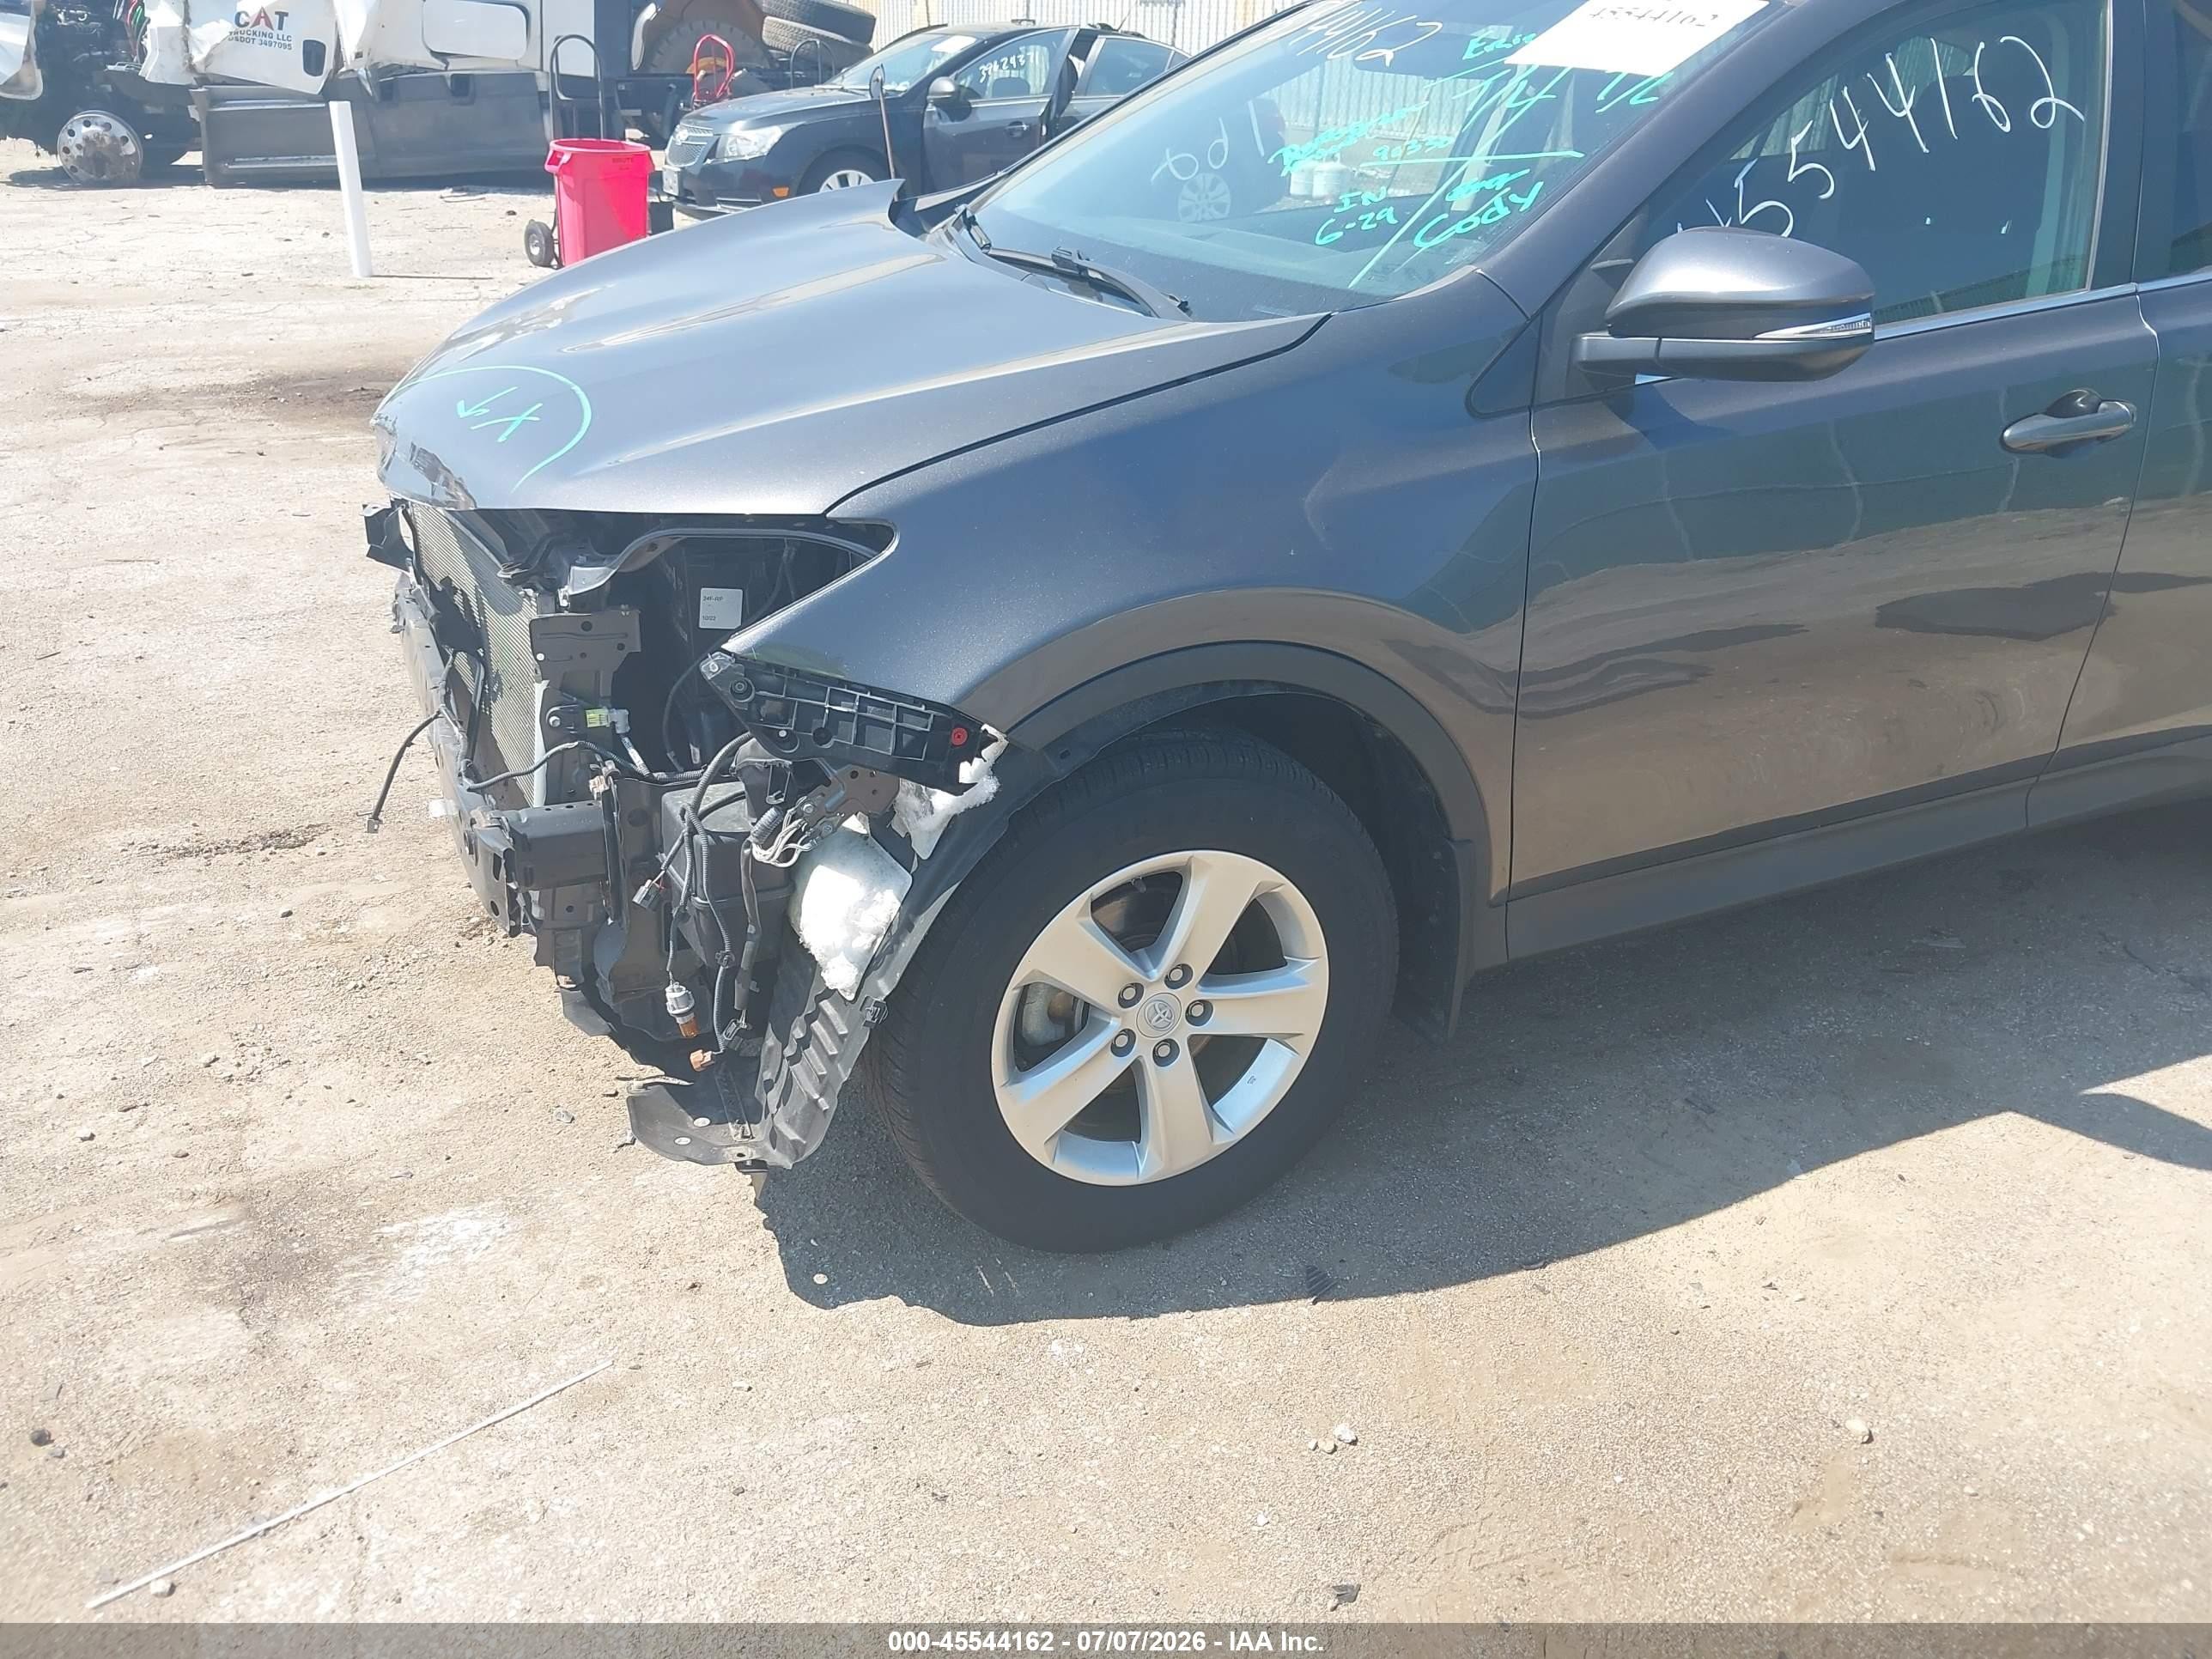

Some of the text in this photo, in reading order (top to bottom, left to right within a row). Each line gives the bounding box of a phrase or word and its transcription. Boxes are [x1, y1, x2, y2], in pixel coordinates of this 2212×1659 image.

[228, 29, 292, 42] TRUCKING LLC
[234, 6, 289, 31] CAT
[1676, 35, 2086, 238] 5544162
[1413, 180, 1545, 249] Cody
